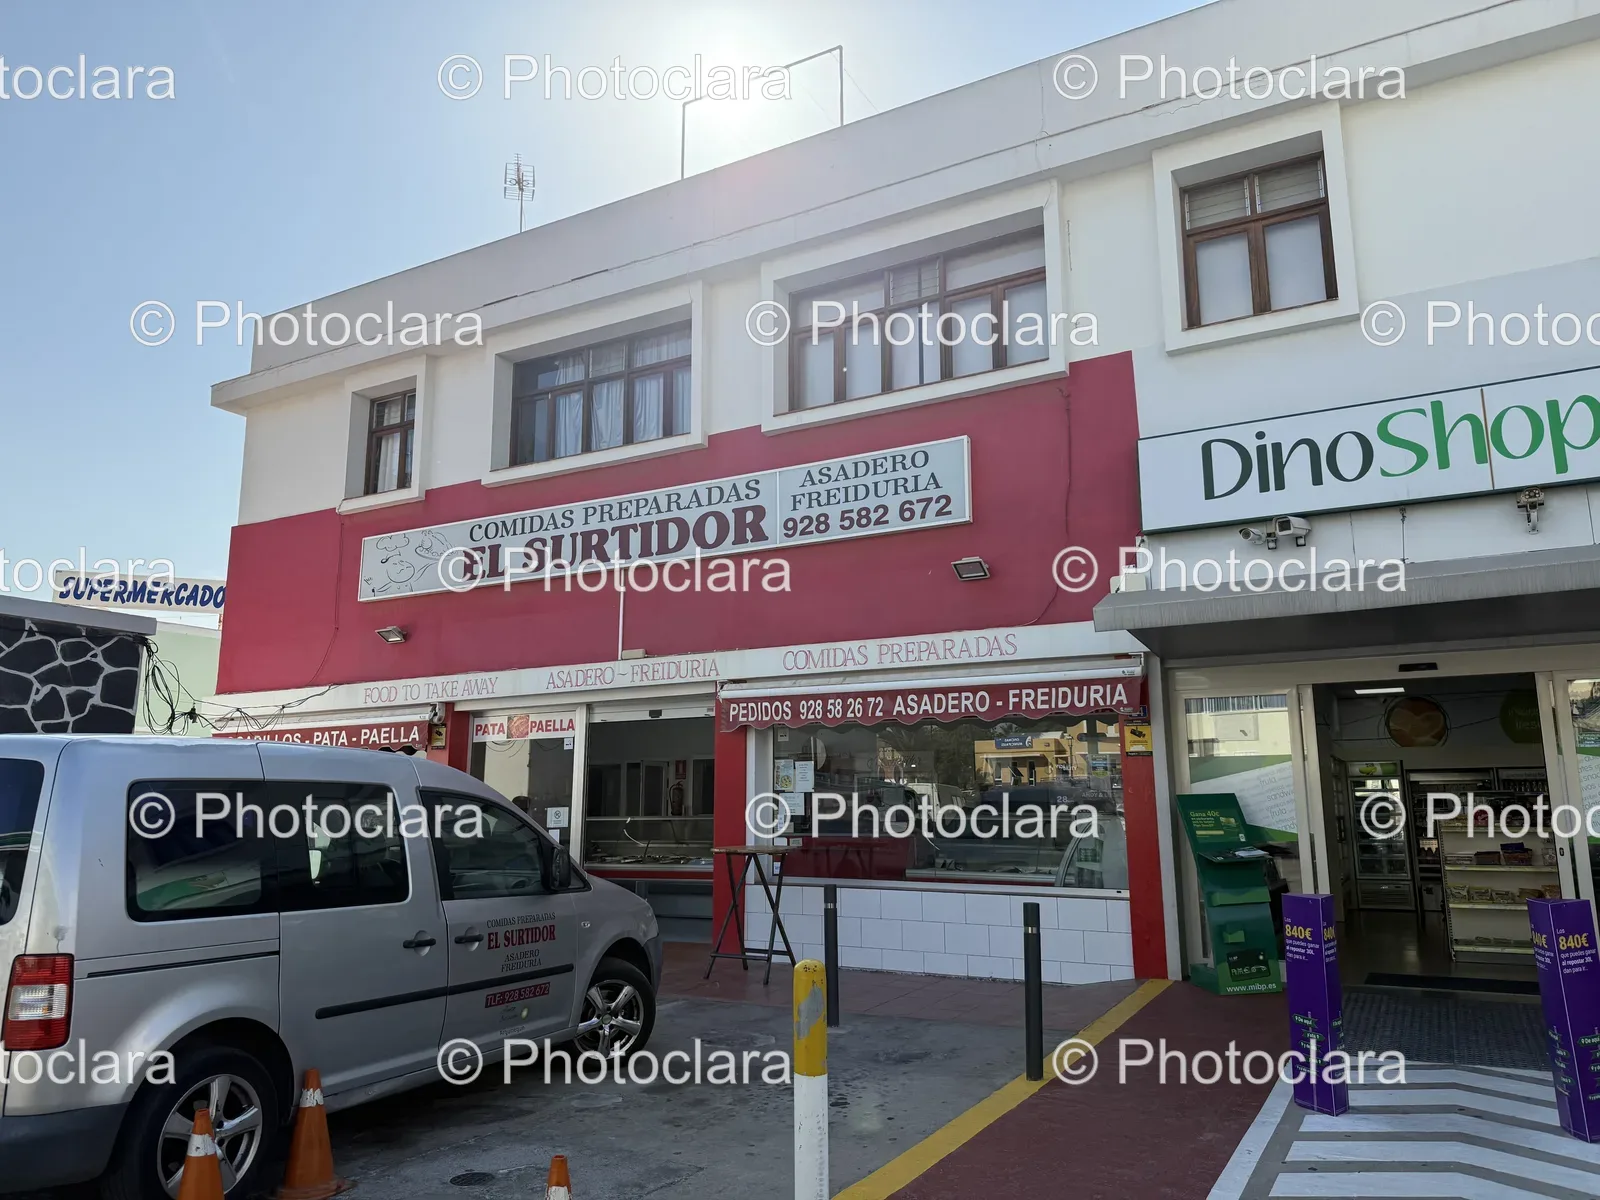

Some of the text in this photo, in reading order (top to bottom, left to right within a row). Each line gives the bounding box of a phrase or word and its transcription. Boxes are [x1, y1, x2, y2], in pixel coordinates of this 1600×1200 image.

[798, 450, 930, 488] ASADERO
[790, 472, 943, 512] FREIDURIA
[469, 478, 761, 542] COMIDAS PREPARADAS
[783, 494, 953, 539] 928 582 672
[522, 504, 770, 574] SURTIDOR
[59, 576, 226, 609] SUPERMERCADO
[782, 633, 1018, 671] COMIDAS PREPARADAS
[545, 666, 616, 690] ASADERO
[630, 658, 721, 683] FREIDURIA
[363, 676, 499, 704] FOOD TO TAKE AWAY
[729, 700, 792, 722] PEDIDOS
[799, 699, 823, 720] 928
[827, 698, 843, 719] 58
[846, 697, 863, 718] 26
[867, 696, 884, 717] 72
[893, 690, 990, 716] ASADERO
[1008, 683, 1128, 711] FREIDURIA
[313, 730, 348, 746] PATA
[361, 725, 420, 745] PAELLA
[475, 718, 575, 737] PATA PAELLA
[486, 911, 556, 929] COMIDAS PREPARADAS
[487, 924, 556, 950] EL SURTIDOR
[501, 958, 542, 973] FREIDURIA
[504, 948, 540, 963] ASADERO
[504, 989, 519, 1003] 928
[520, 986, 535, 999] 582
[535, 983, 550, 997] 672
[1226, 982, 1277, 993] www.mibp.es
